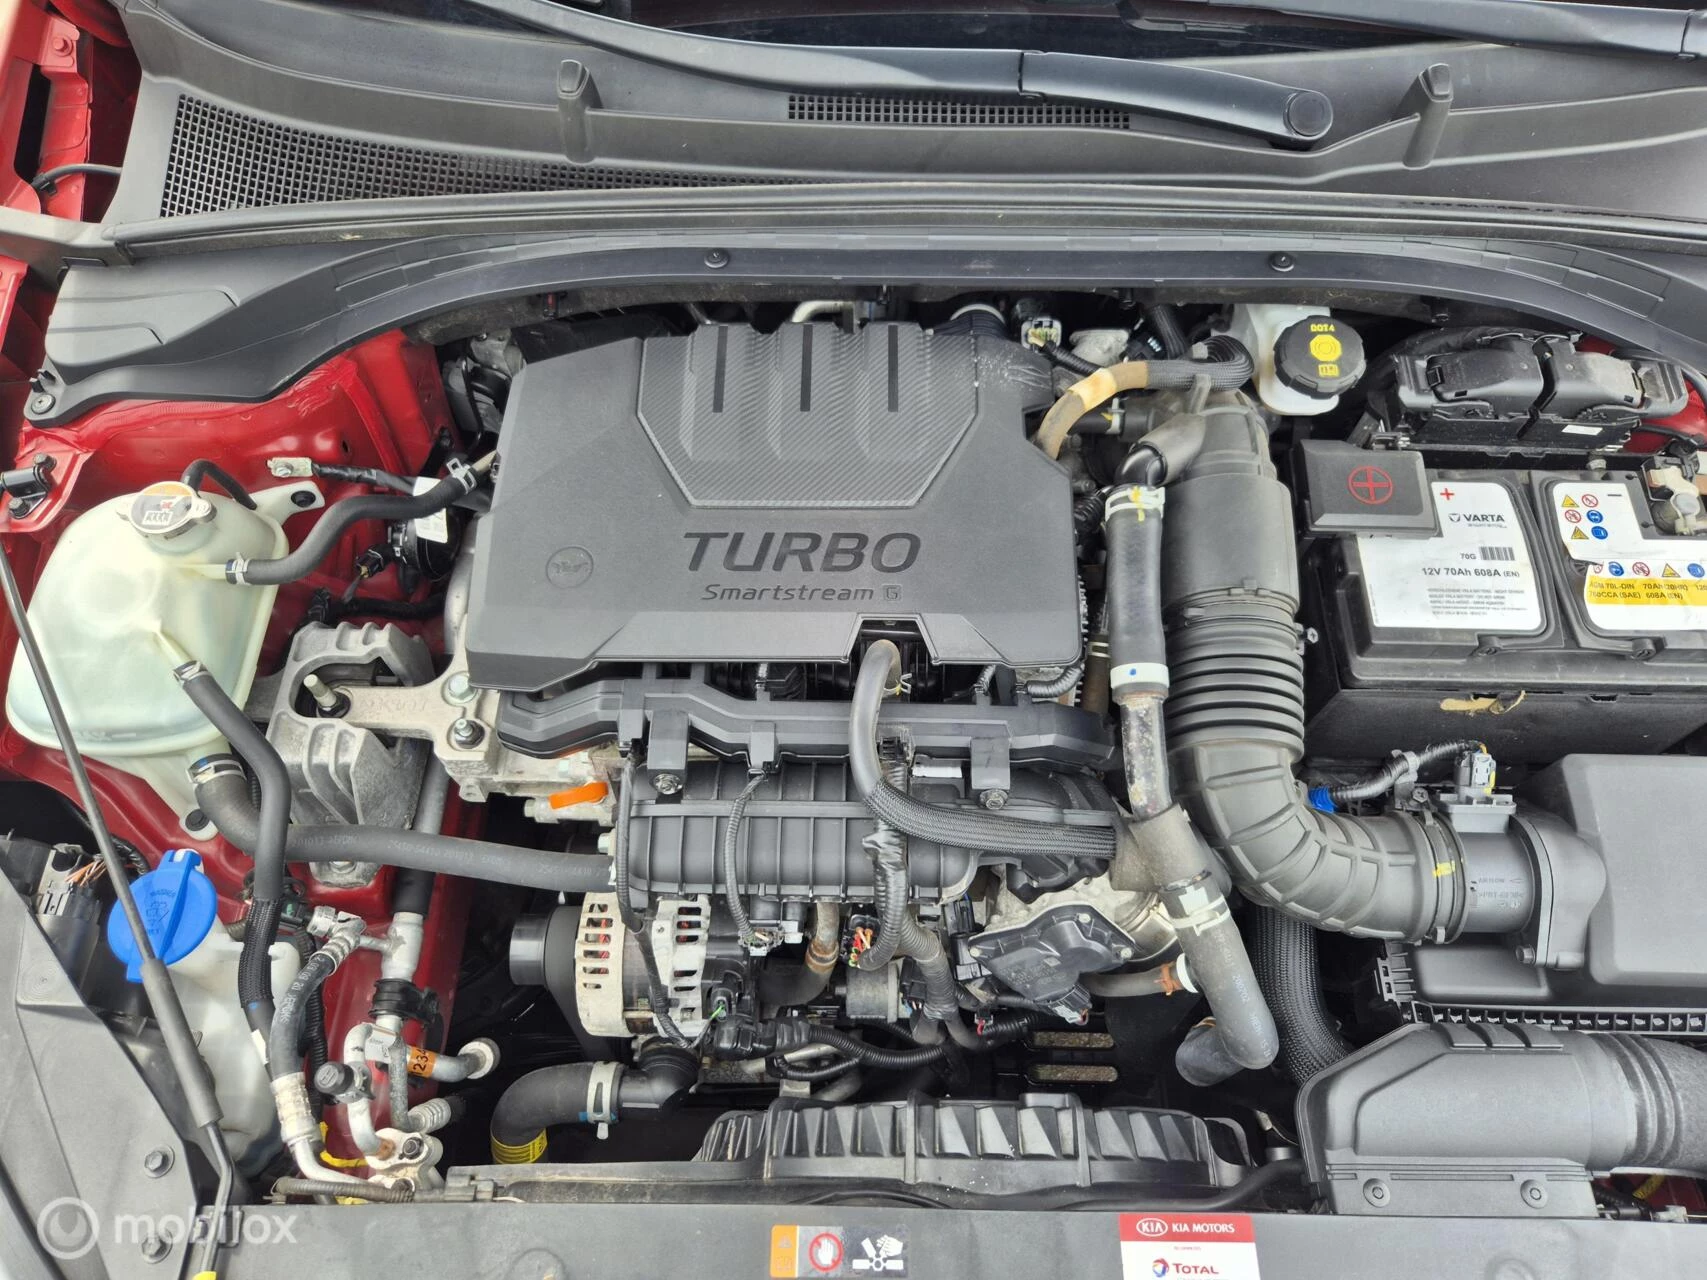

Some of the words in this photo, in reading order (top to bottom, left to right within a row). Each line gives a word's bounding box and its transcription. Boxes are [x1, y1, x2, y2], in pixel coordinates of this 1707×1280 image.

[1463, 513, 1505, 522] VARTA
[683, 531, 922, 573] TURBO
[1421, 567, 1441, 576] 12V
[1443, 567, 1472, 576] 70Ah
[1474, 568, 1501, 577] 608A
[702, 583, 874, 601] Smartstream
[1172, 1223, 1190, 1232] KIA
[1192, 1223, 1236, 1233] MOTORS
[1172, 1263, 1220, 1275] TOTAL
